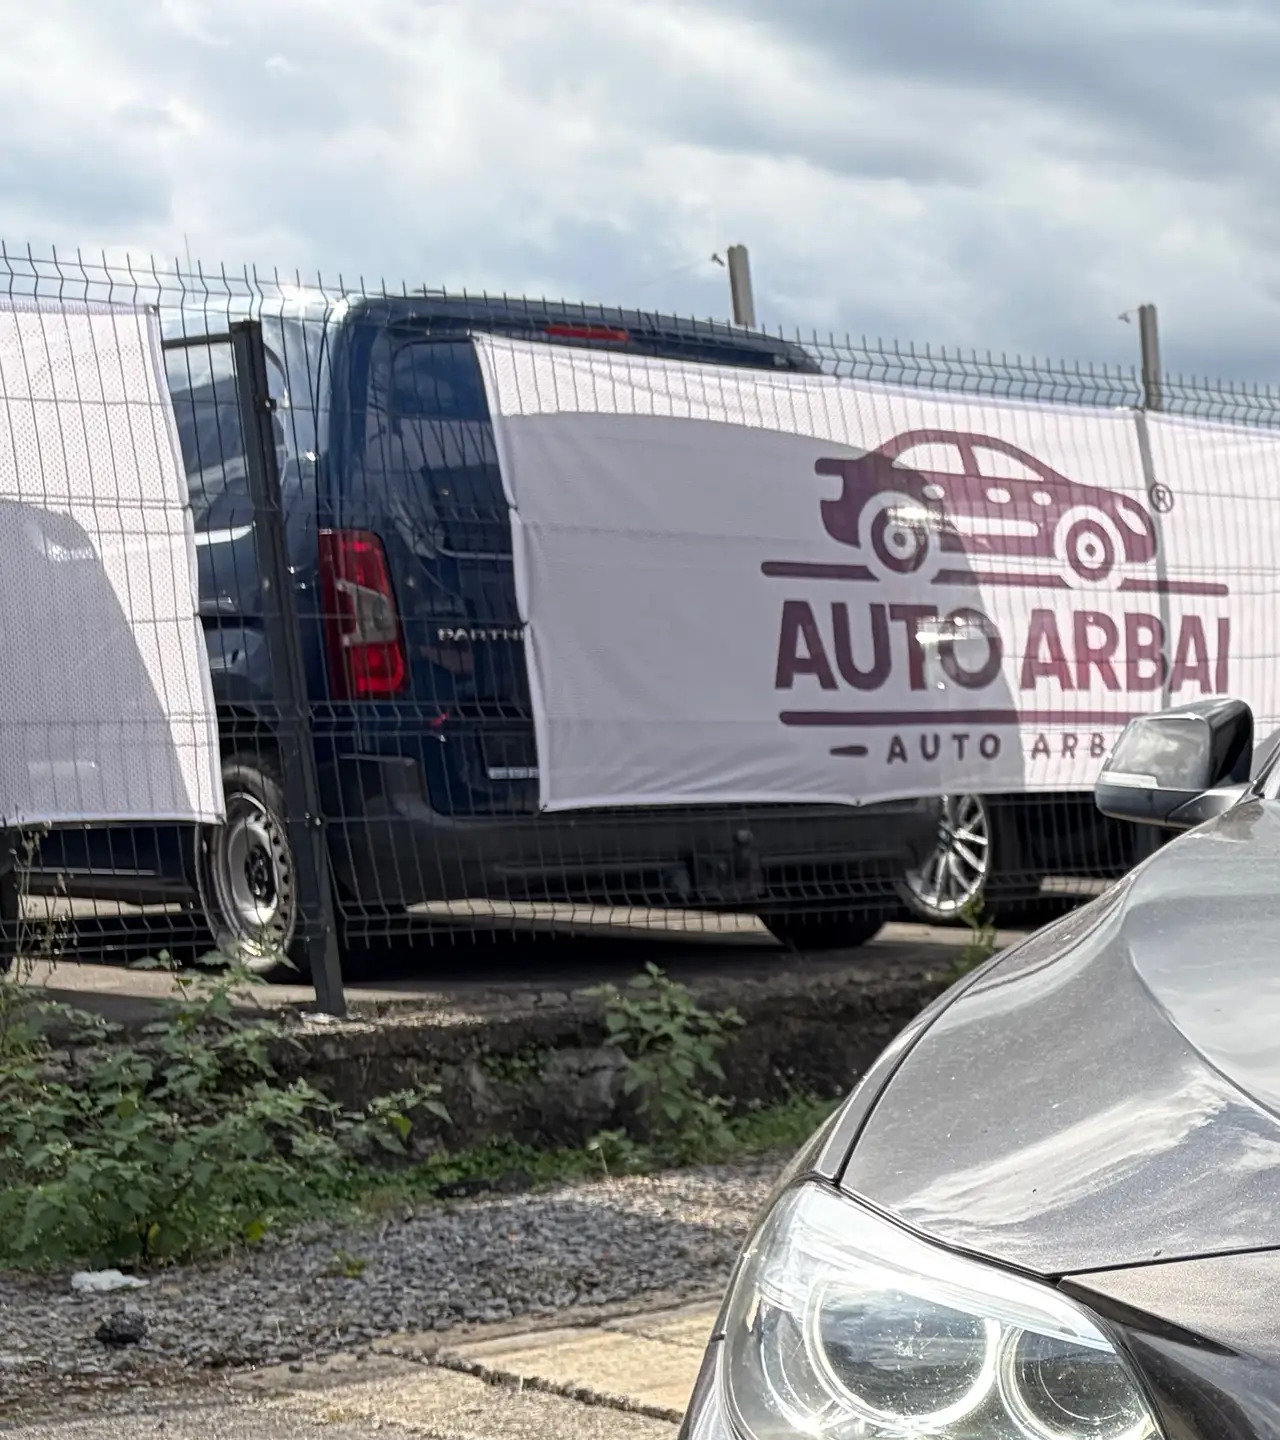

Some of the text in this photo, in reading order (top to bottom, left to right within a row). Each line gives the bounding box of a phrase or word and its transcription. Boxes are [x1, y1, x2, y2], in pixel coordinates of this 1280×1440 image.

[437, 627, 525, 642] PARTN
[775, 600, 1230, 695] AUTO ARBAI
[886, 731, 1108, 765] AUTO ARB
